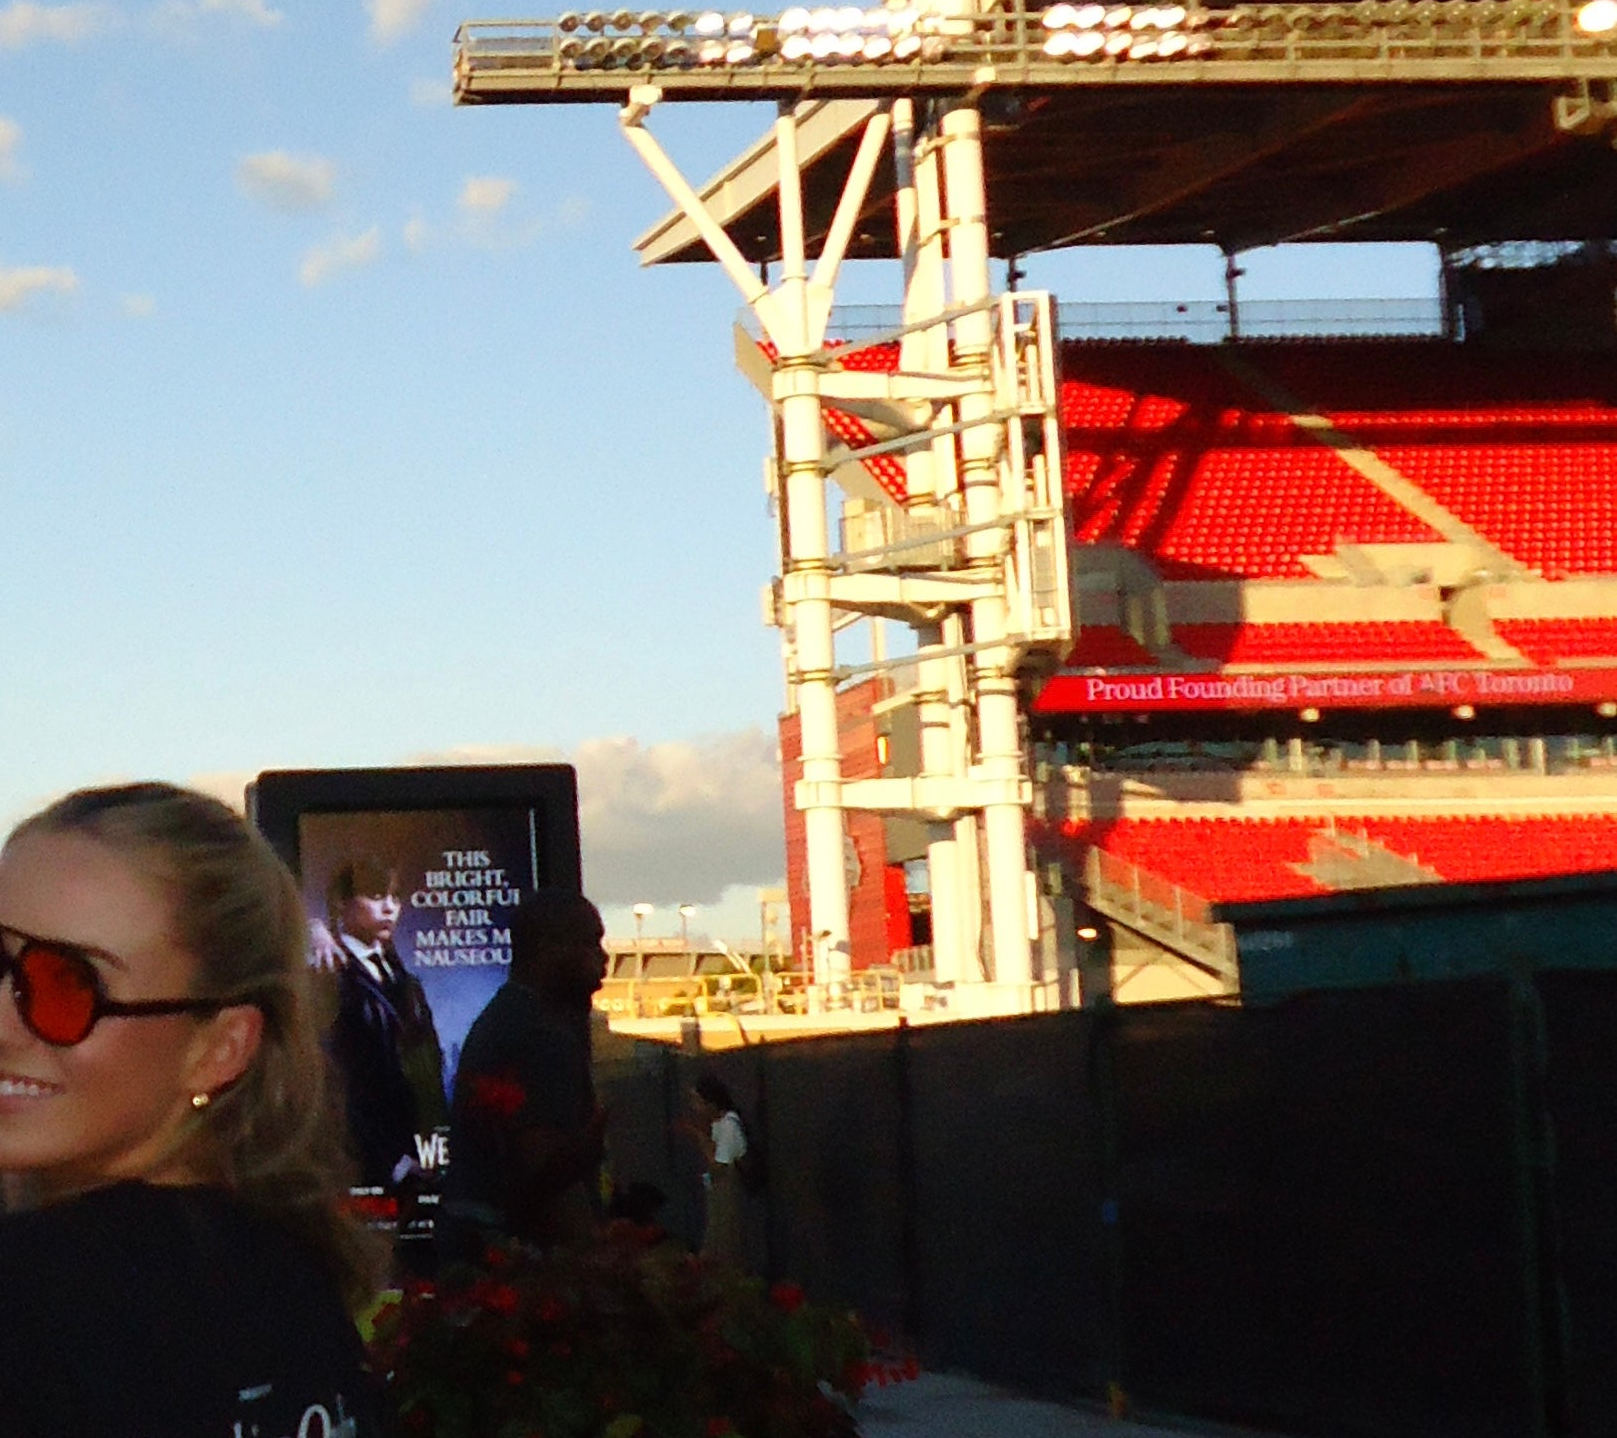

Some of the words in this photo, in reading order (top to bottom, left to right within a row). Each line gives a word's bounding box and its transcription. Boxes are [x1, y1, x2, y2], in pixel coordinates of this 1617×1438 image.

[1086, 676, 1163, 701] Proud
[1168, 675, 1287, 703] Founding
[1289, 673, 1385, 698] Partner
[1388, 672, 1413, 696] of
[1473, 672, 1574, 694] Toronto
[442, 850, 491, 868] THIS
[425, 869, 510, 889] BRIGHT,
[445, 908, 493, 927] FAIR
[416, 928, 488, 948] MAKES
[492, 928, 512, 945] M
[414, 947, 513, 967] NAUSEOU
